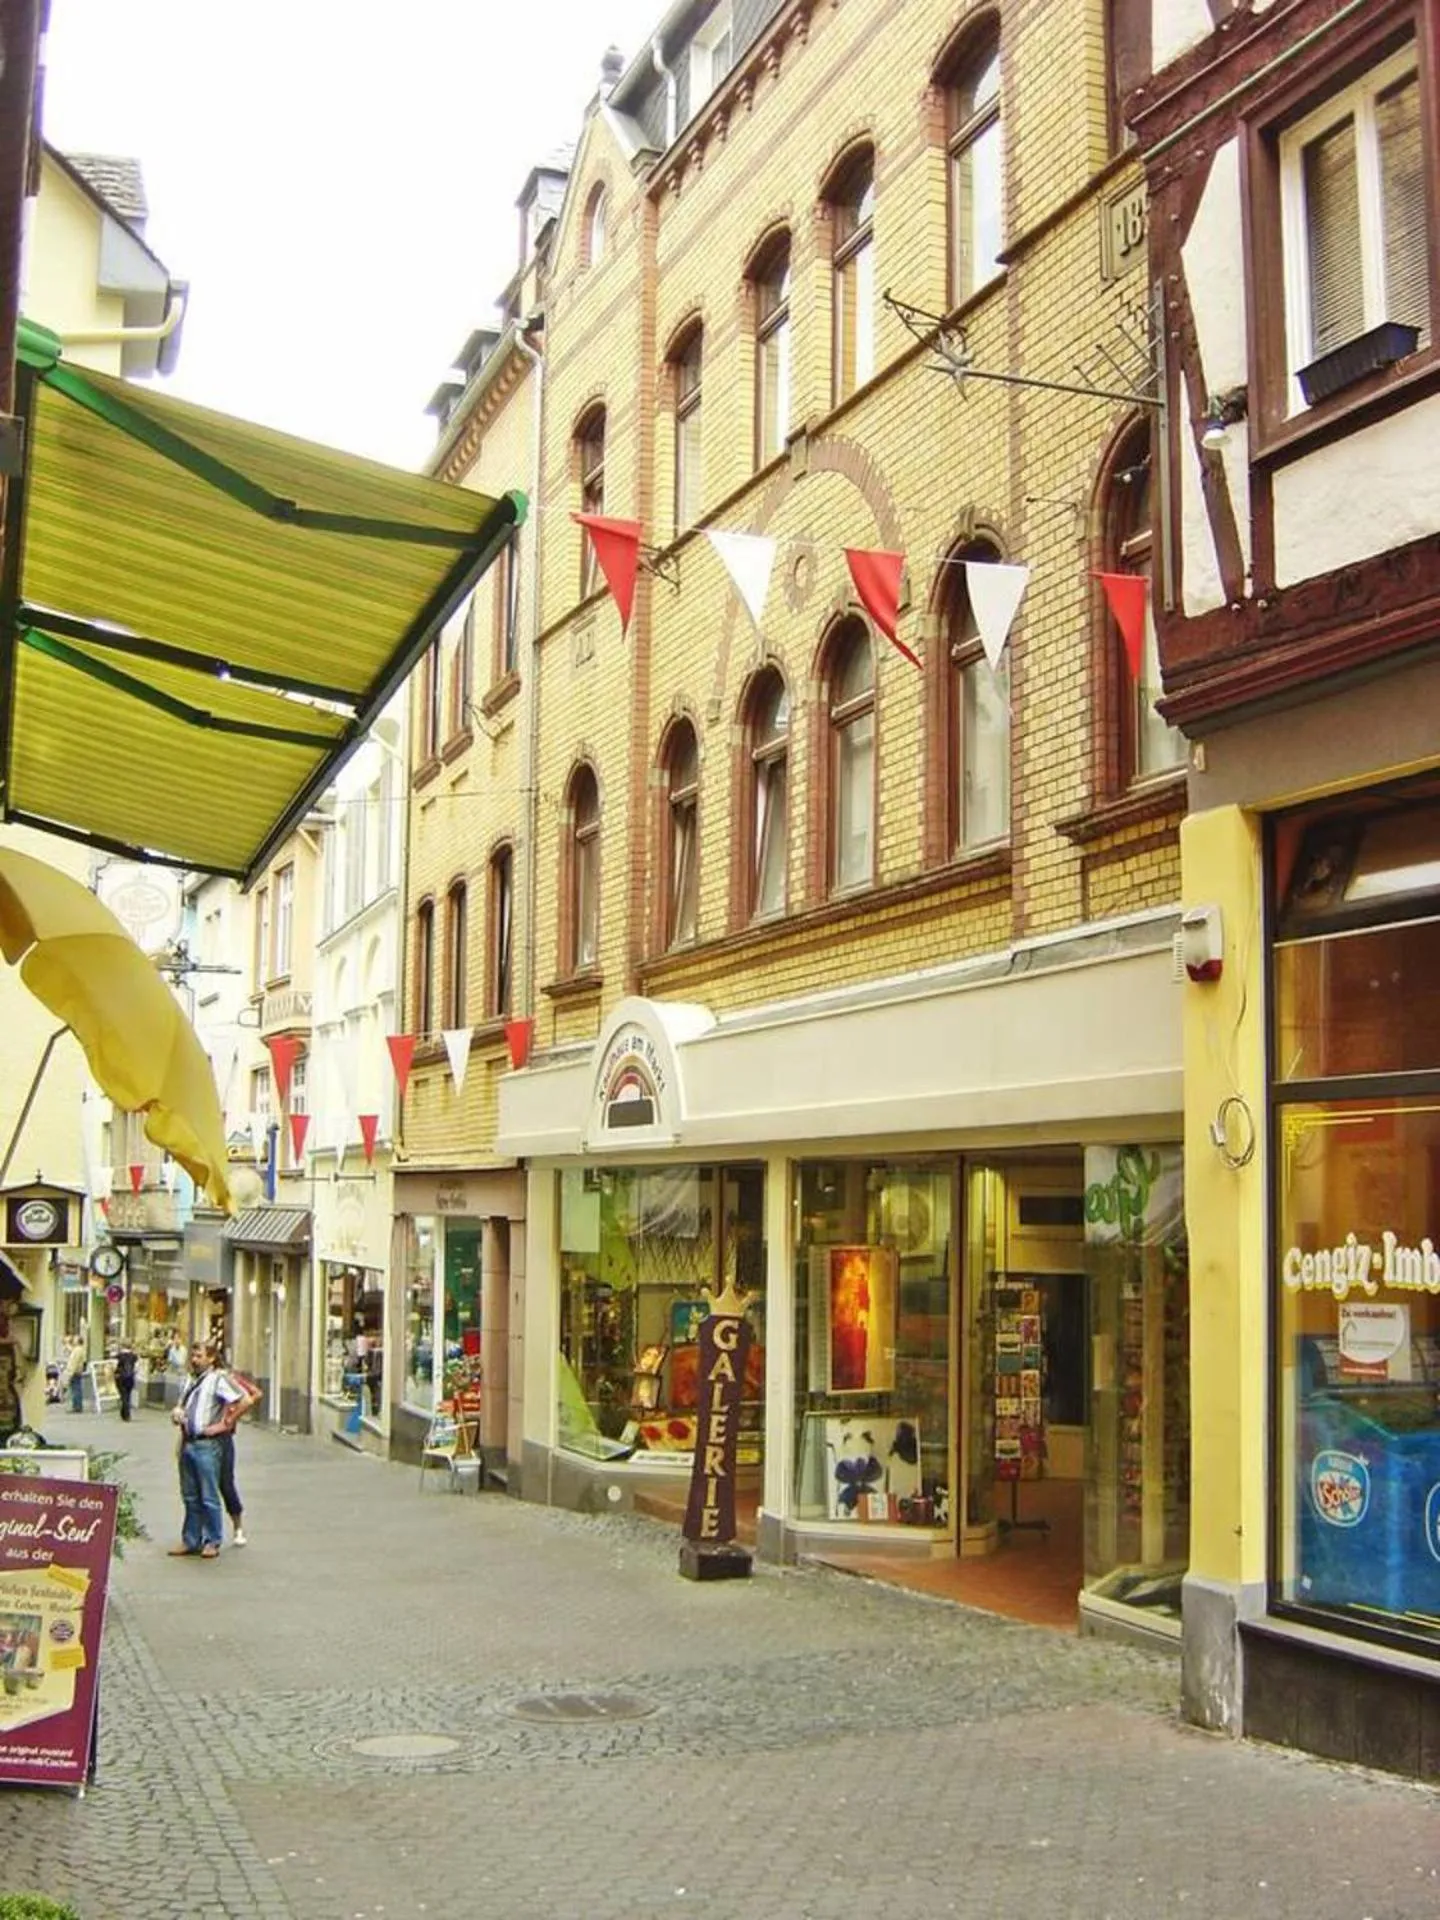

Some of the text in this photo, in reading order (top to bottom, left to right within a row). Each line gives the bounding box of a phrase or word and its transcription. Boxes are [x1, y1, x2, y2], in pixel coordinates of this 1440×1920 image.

[700, 1318, 739, 1538] GALERIE
[1, 1489, 104, 1511] erhalten Sie den
[5, 1547, 55, 1562] aus der
